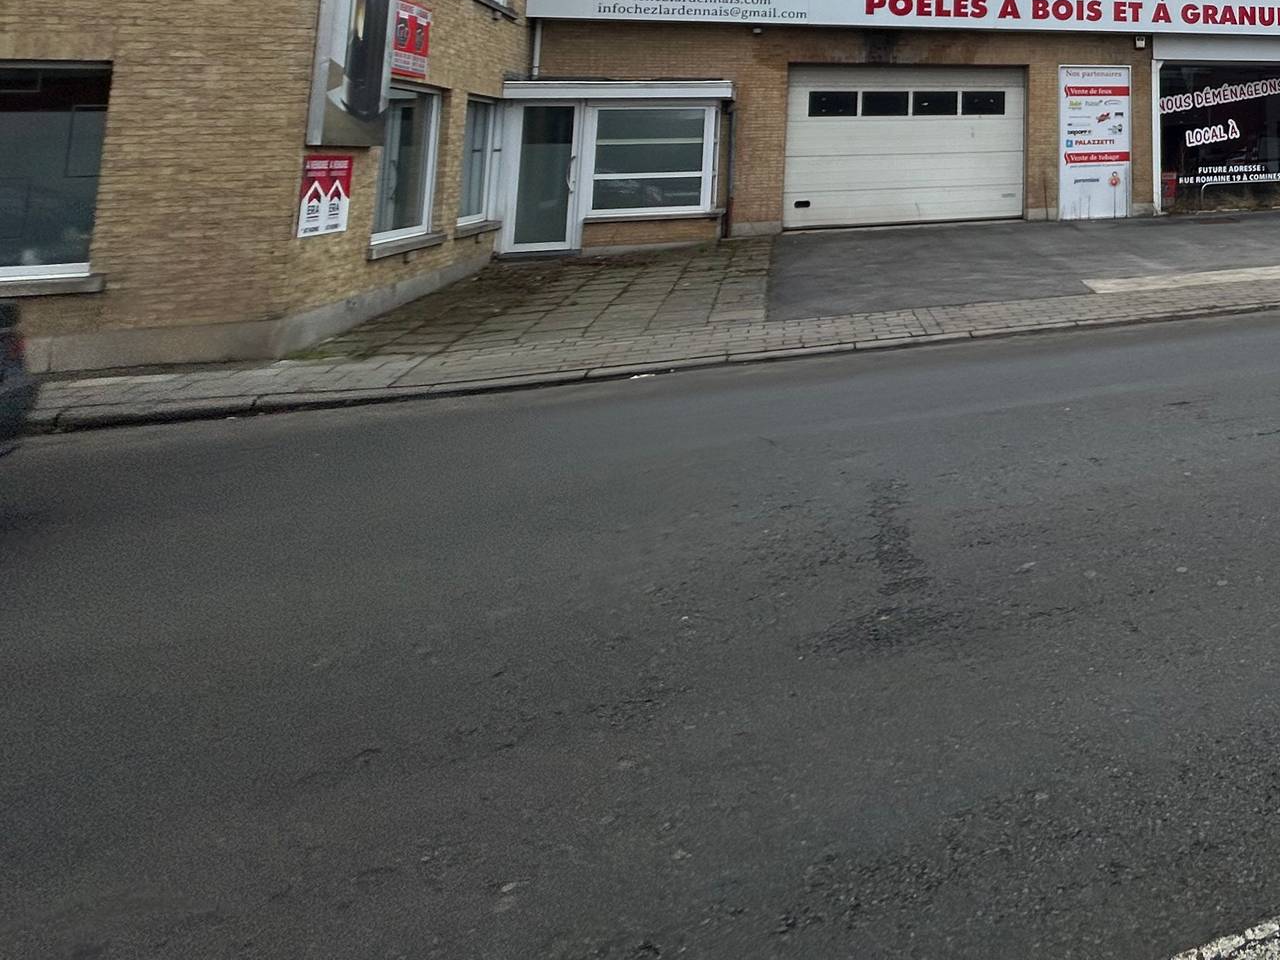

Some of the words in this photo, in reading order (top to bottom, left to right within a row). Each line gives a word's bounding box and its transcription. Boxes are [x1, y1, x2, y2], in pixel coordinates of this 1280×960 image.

[597, 4, 807, 19] infochezlardennais@gmail.com
[1113, 1, 1143, 22] ET
[1186, 125, 1227, 147] LOCAL
[1228, 119, 1240, 139] À
[1198, 165, 1227, 174] FUTURE
[1228, 164, 1260, 173] ADRESSE
[1195, 173, 1230, 183] ROMAINE
[1231, 174, 1241, 182] 19
